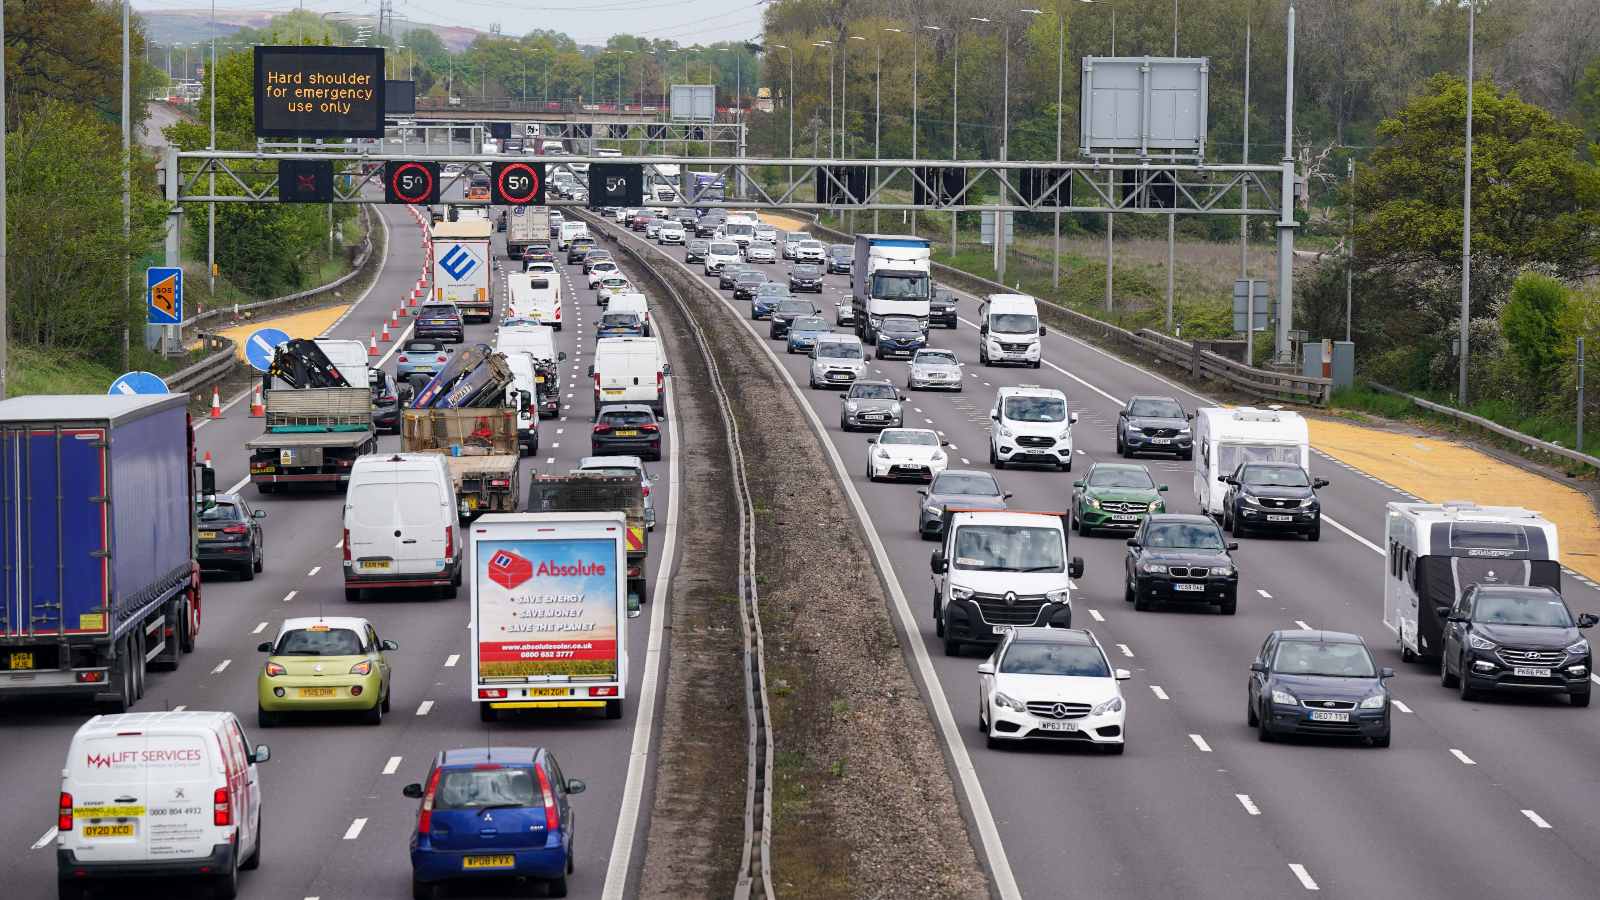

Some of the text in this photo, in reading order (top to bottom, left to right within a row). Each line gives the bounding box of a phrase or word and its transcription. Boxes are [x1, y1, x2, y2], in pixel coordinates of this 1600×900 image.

[268, 72, 370, 84] Hard shoulder
[266, 86, 372, 100] for emergency
[288, 101, 350, 114] use only
[508, 176, 528, 190] 50
[536, 559, 605, 576] Absolute
[544, 594, 584, 603] ENERGY
[519, 609, 583, 618] SAVE MONEY
[507, 624, 533, 632] SAVE
[556, 623, 595, 631] PLANET
[112, 751, 138, 762] LIFT
[142, 750, 201, 762] SERVICES
[86, 826, 129, 835] OY20 XCO
[468, 855, 510, 865] WP08 FVX
